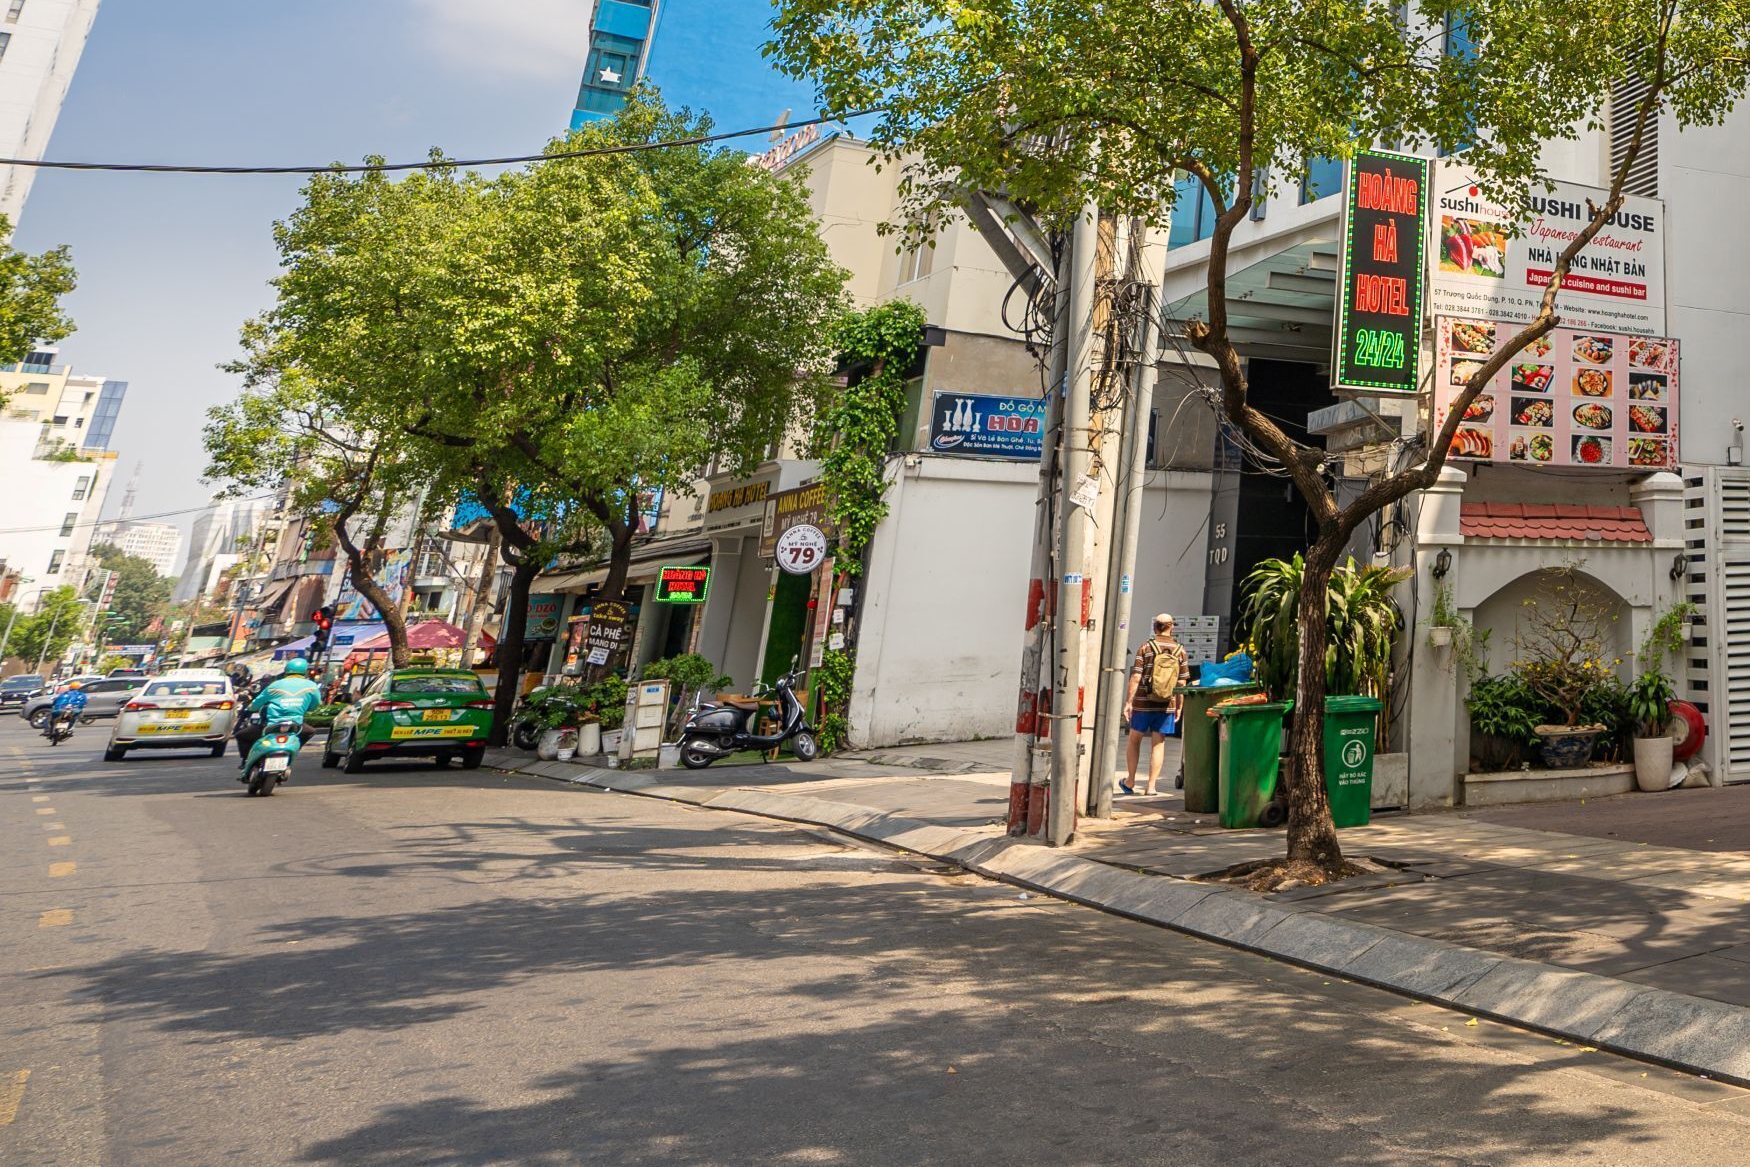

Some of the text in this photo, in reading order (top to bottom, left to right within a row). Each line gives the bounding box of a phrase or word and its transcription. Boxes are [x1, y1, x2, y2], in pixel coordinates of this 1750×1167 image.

[1358, 168, 1417, 215] HOÀNG
[1440, 197, 1479, 213] sushi
[1520, 195, 1581, 221] SUSHI
[1374, 219, 1398, 263] HÀ
[1586, 232, 1643, 252] estaurant
[1528, 247, 1645, 277] NHÀ HNG NHẬT BẢN
[1356, 274, 1409, 316] HOTEL
[1567, 278, 1594, 290] cuisine
[1596, 282, 1610, 292] and
[1611, 284, 1632, 295] sushi
[1633, 287, 1645, 297] bar
[1355, 329, 1404, 369] 24/24
[778, 485, 825, 514] ANNA COFFEE
[786, 528, 821, 539] ANNA COFFEE
[1216, 523, 1226, 539] 55
[789, 547, 815, 564] 79
[1209, 547, 1228, 565] TQD
[590, 624, 622, 640] CÀ PHÊ
[589, 638, 609, 649] MANG
